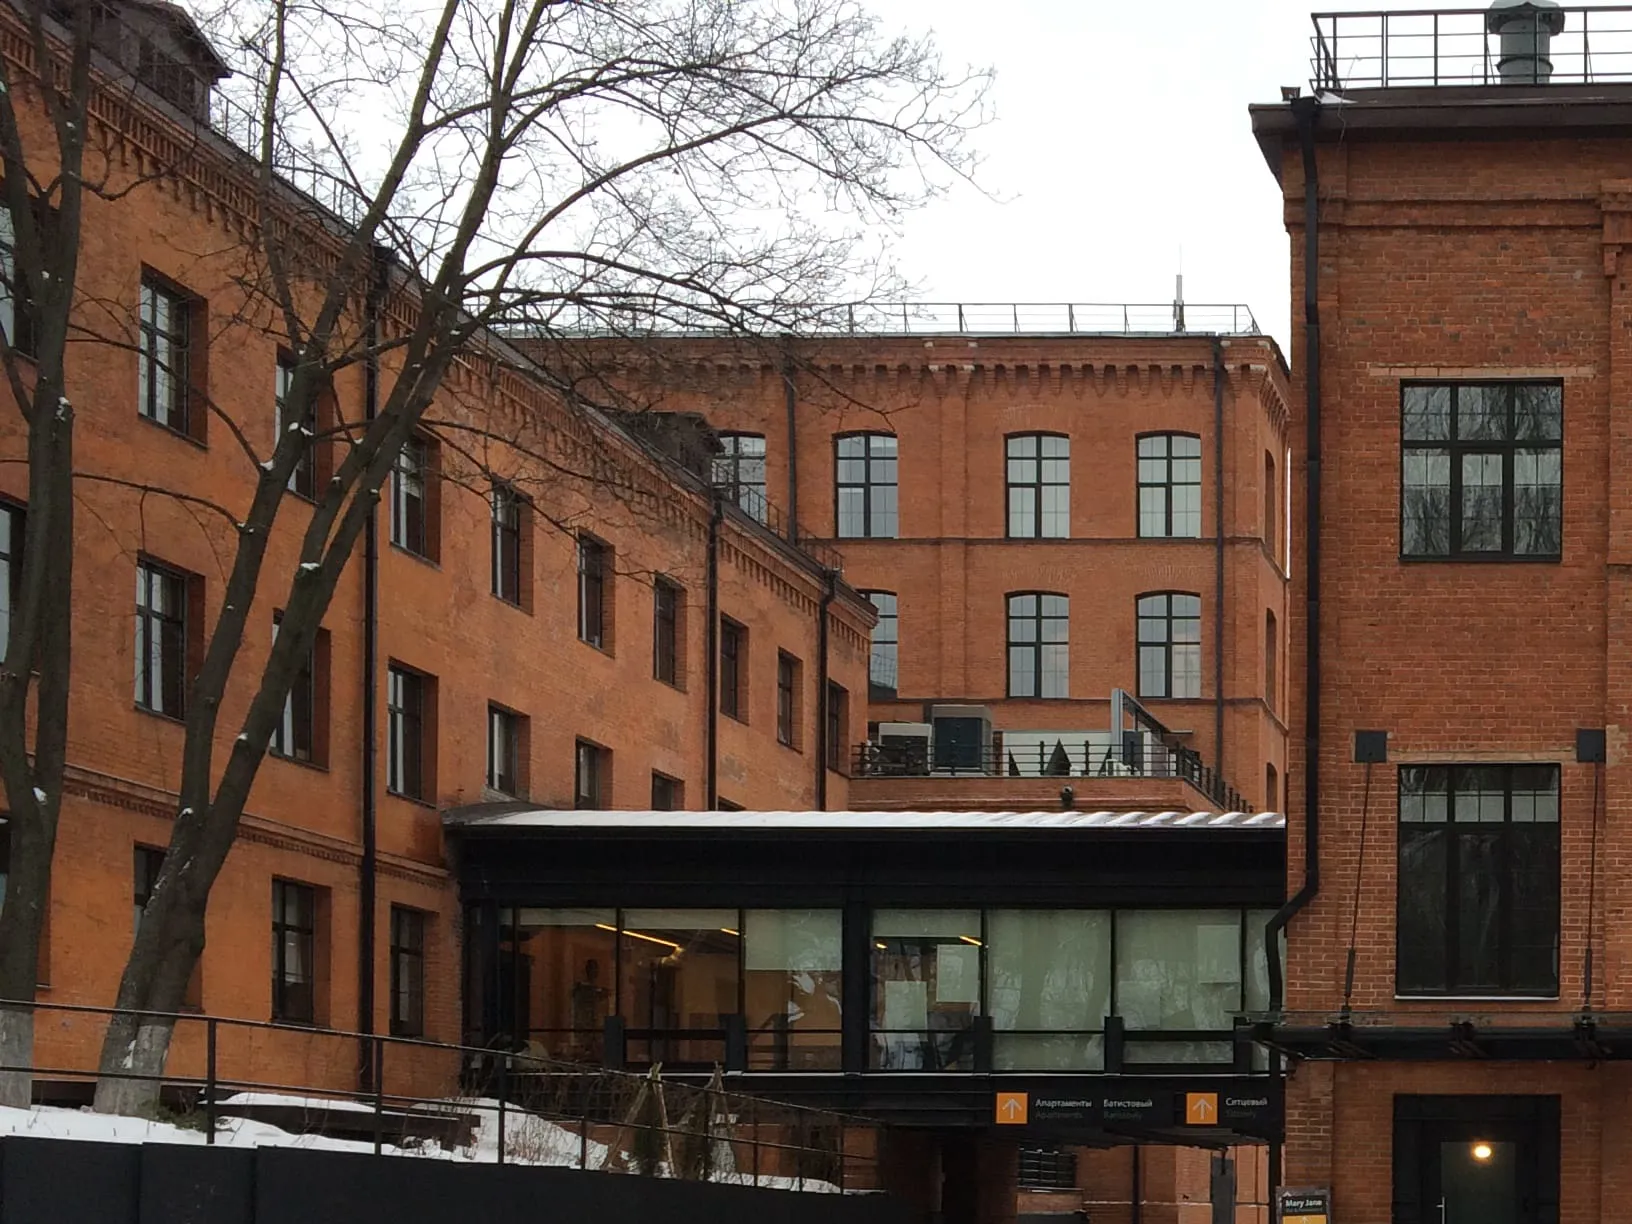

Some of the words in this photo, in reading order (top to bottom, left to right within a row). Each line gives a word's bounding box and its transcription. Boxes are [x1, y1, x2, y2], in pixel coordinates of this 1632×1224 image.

[1034, 1098, 1093, 1110] Апартаменты
[1103, 1097, 1153, 1109] Батистовый
[1225, 1096, 1268, 1108] Ситцевый
[1285, 1199, 1304, 1209] Mary
[1305, 1199, 1323, 1207] Jane
